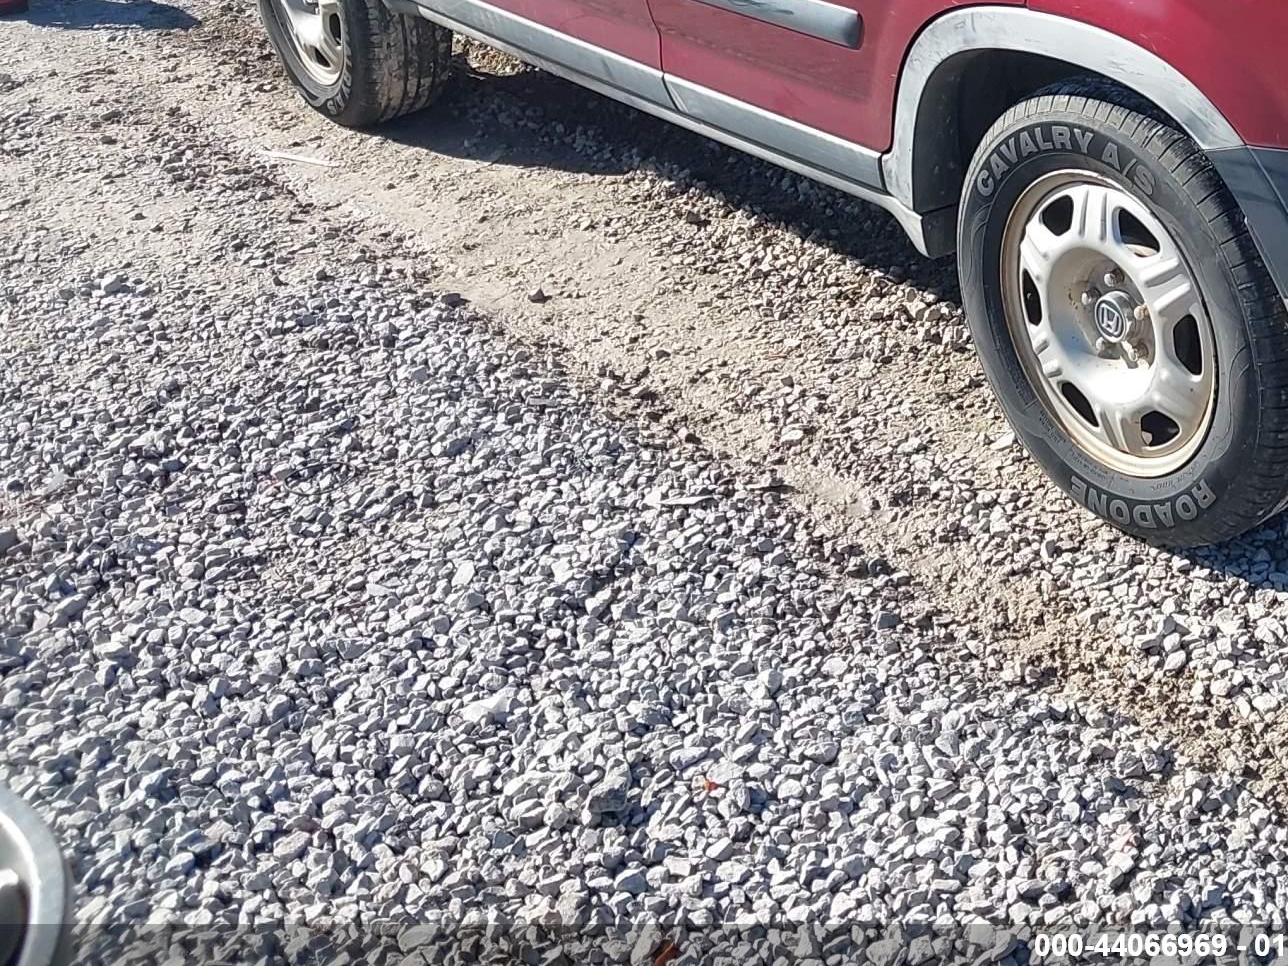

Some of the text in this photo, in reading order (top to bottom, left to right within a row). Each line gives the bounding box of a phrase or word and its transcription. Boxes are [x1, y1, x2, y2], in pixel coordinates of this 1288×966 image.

[976, 125, 1157, 197] CAVALRY A/S
[1069, 476, 1217, 529] ROADONE
